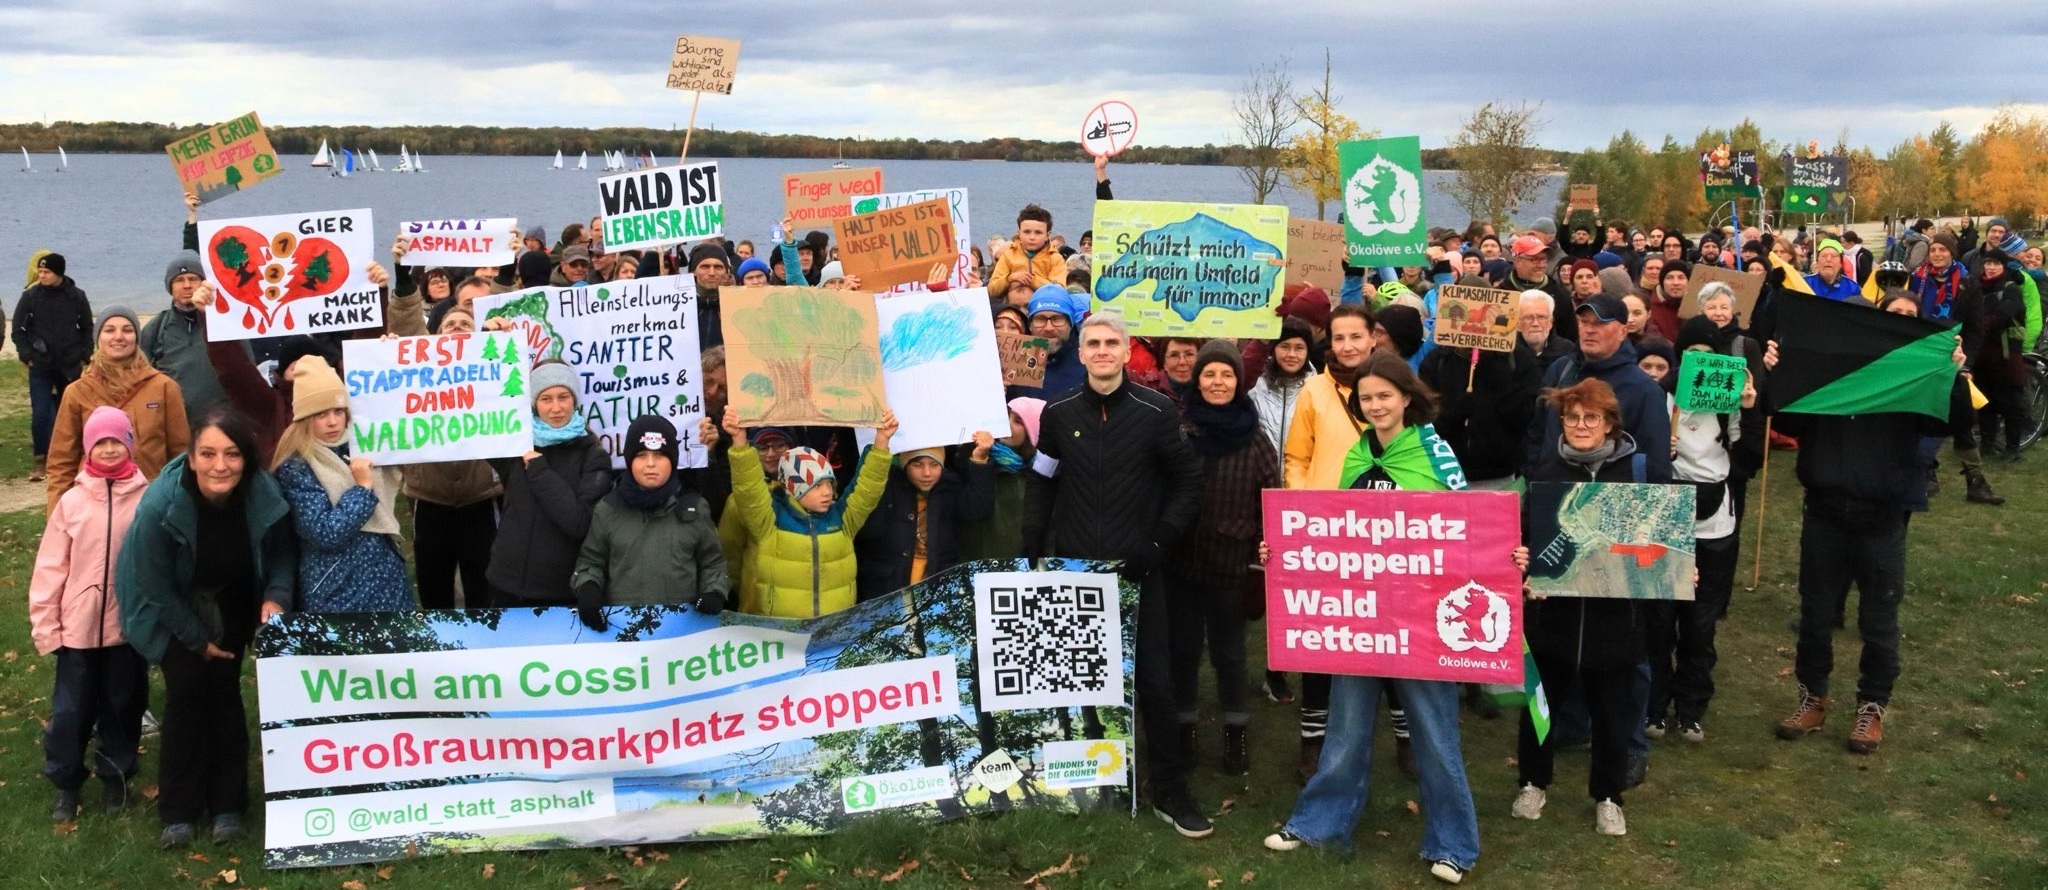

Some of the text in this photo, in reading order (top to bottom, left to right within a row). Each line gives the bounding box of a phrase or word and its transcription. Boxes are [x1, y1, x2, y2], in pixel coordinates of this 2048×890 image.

[672, 58, 711, 71] wichtiger
[701, 56, 722, 66] sind
[712, 66, 732, 78] als
[170, 132, 215, 164] MEHR
[211, 140, 256, 170] LEIPZIG
[1794, 157, 1834, 175] Lasst
[600, 165, 717, 216] WALD IST
[787, 171, 882, 201] Finger weg!
[299, 216, 353, 235] GIER
[603, 203, 724, 246] LEBENSRAUM
[789, 208, 815, 220] von
[842, 204, 937, 237] HALT DAS IST
[408, 235, 493, 253] ASPHALT
[847, 233, 889, 254] UNSER
[1116, 232, 1246, 259] Schützt mich
[1349, 242, 1426, 255] Ökolöwe e.V.
[1102, 261, 1261, 289] und mein Umfeld
[324, 291, 378, 308] MACHT
[559, 284, 694, 317] Alleinstellungs-
[1165, 284, 1194, 309] für
[1443, 286, 1510, 304] KLIMASCHUTZ
[309, 306, 374, 328] KRANK
[611, 313, 686, 335] merkmal
[398, 334, 471, 366] ERST
[570, 334, 673, 366] SANFTER
[347, 363, 500, 397] STADTRADELN
[580, 369, 688, 394] Tourismus &
[406, 384, 475, 414] DANN
[669, 395, 700, 417] sind
[1714, 392, 1731, 401] WITH
[354, 408, 522, 453] WALDRODUNG
[1281, 510, 1466, 545] Parkplatz
[1282, 545, 1444, 580] stoppen!
[1283, 589, 1377, 618] Wald
[1286, 624, 1409, 655] retten!
[301, 638, 784, 703] Wald am Cossi retten
[1438, 655, 1511, 670] Ökolöwe e.V.
[303, 670, 943, 774] Großraumparkplatz stoppen!
[981, 762, 1012, 774] team
[1048, 760, 1098, 770] BÜNDNIS 90
[1048, 771, 1060, 780] DIE
[1064, 768, 1097, 778] GRÜNEN
[879, 777, 945, 795] Ökolöwe
[348, 789, 595, 832] @wald_statt_asphalt
